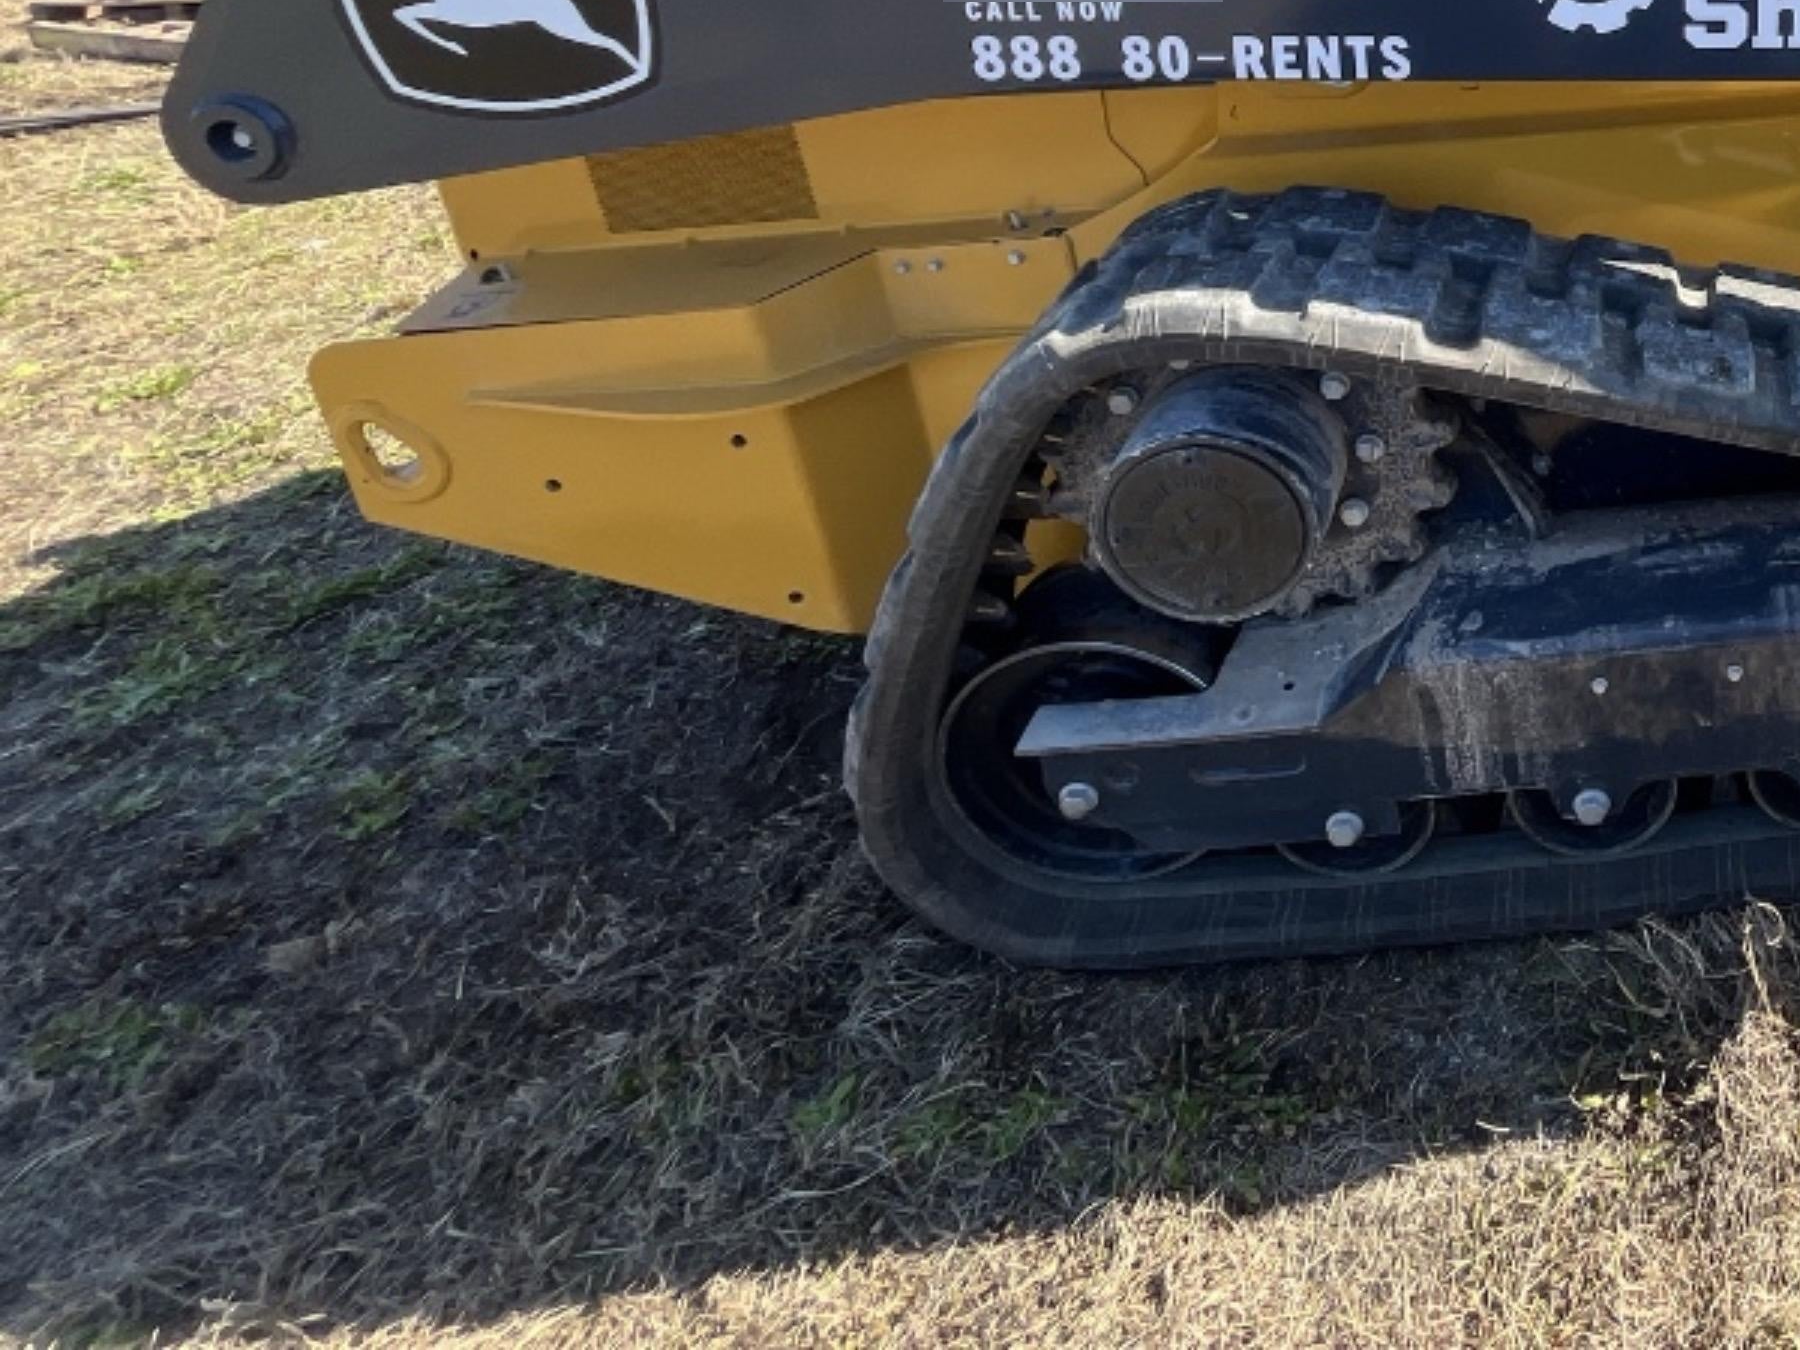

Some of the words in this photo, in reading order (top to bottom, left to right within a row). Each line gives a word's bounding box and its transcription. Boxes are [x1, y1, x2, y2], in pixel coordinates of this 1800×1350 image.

[964, 1, 1042, 22] CALL
[1055, 1, 1124, 22] NOW
[970, 35, 1081, 81] 888
[1120, 34, 1413, 81] 80-RENTS
